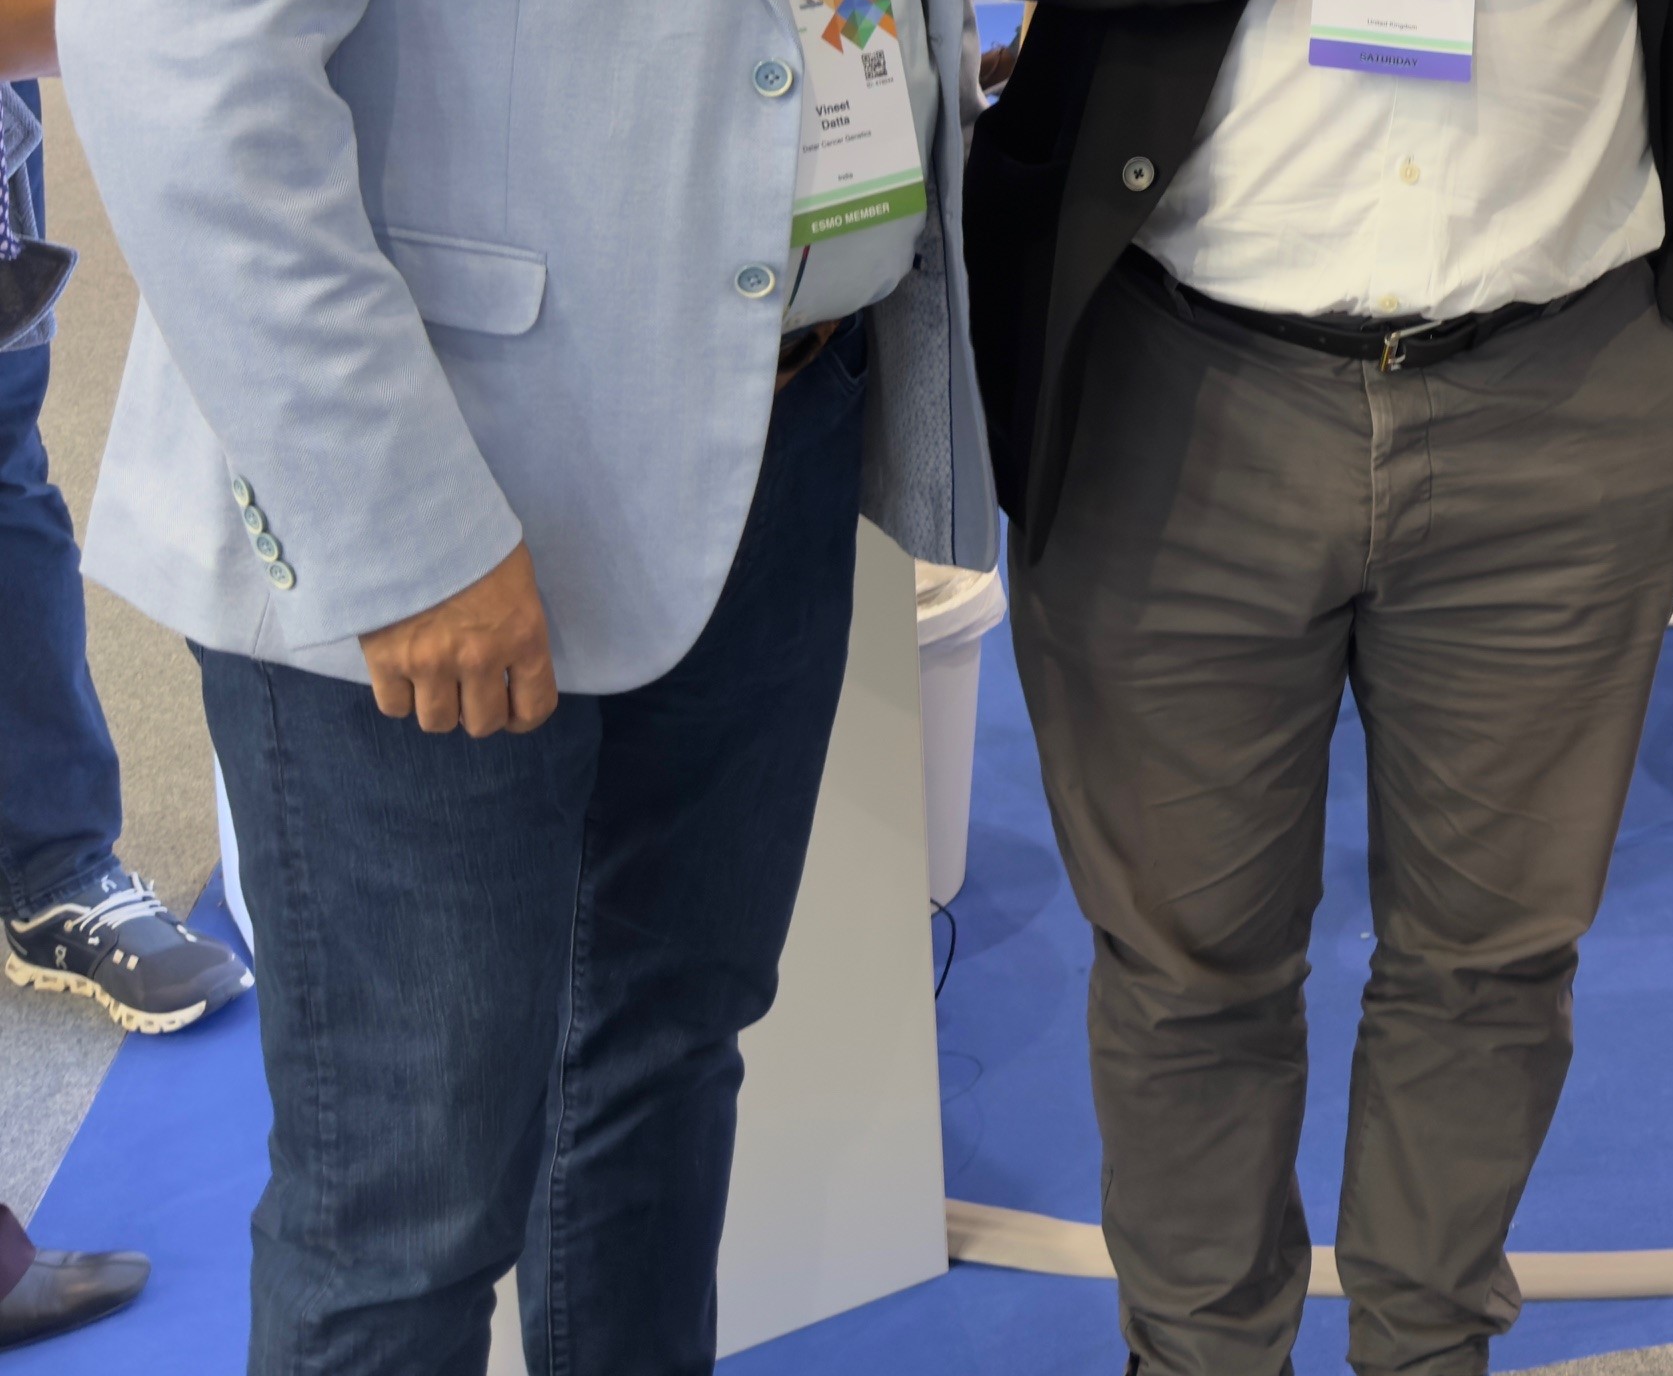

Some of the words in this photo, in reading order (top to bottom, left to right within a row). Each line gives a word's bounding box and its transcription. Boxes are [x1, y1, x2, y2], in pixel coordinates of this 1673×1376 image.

[1360, 52, 1418, 67] SATURDAY
[816, 99, 850, 116] Vineet
[821, 116, 850, 131] Datta
[811, 214, 843, 234] ESMO
[845, 201, 890, 225] MEMBER
